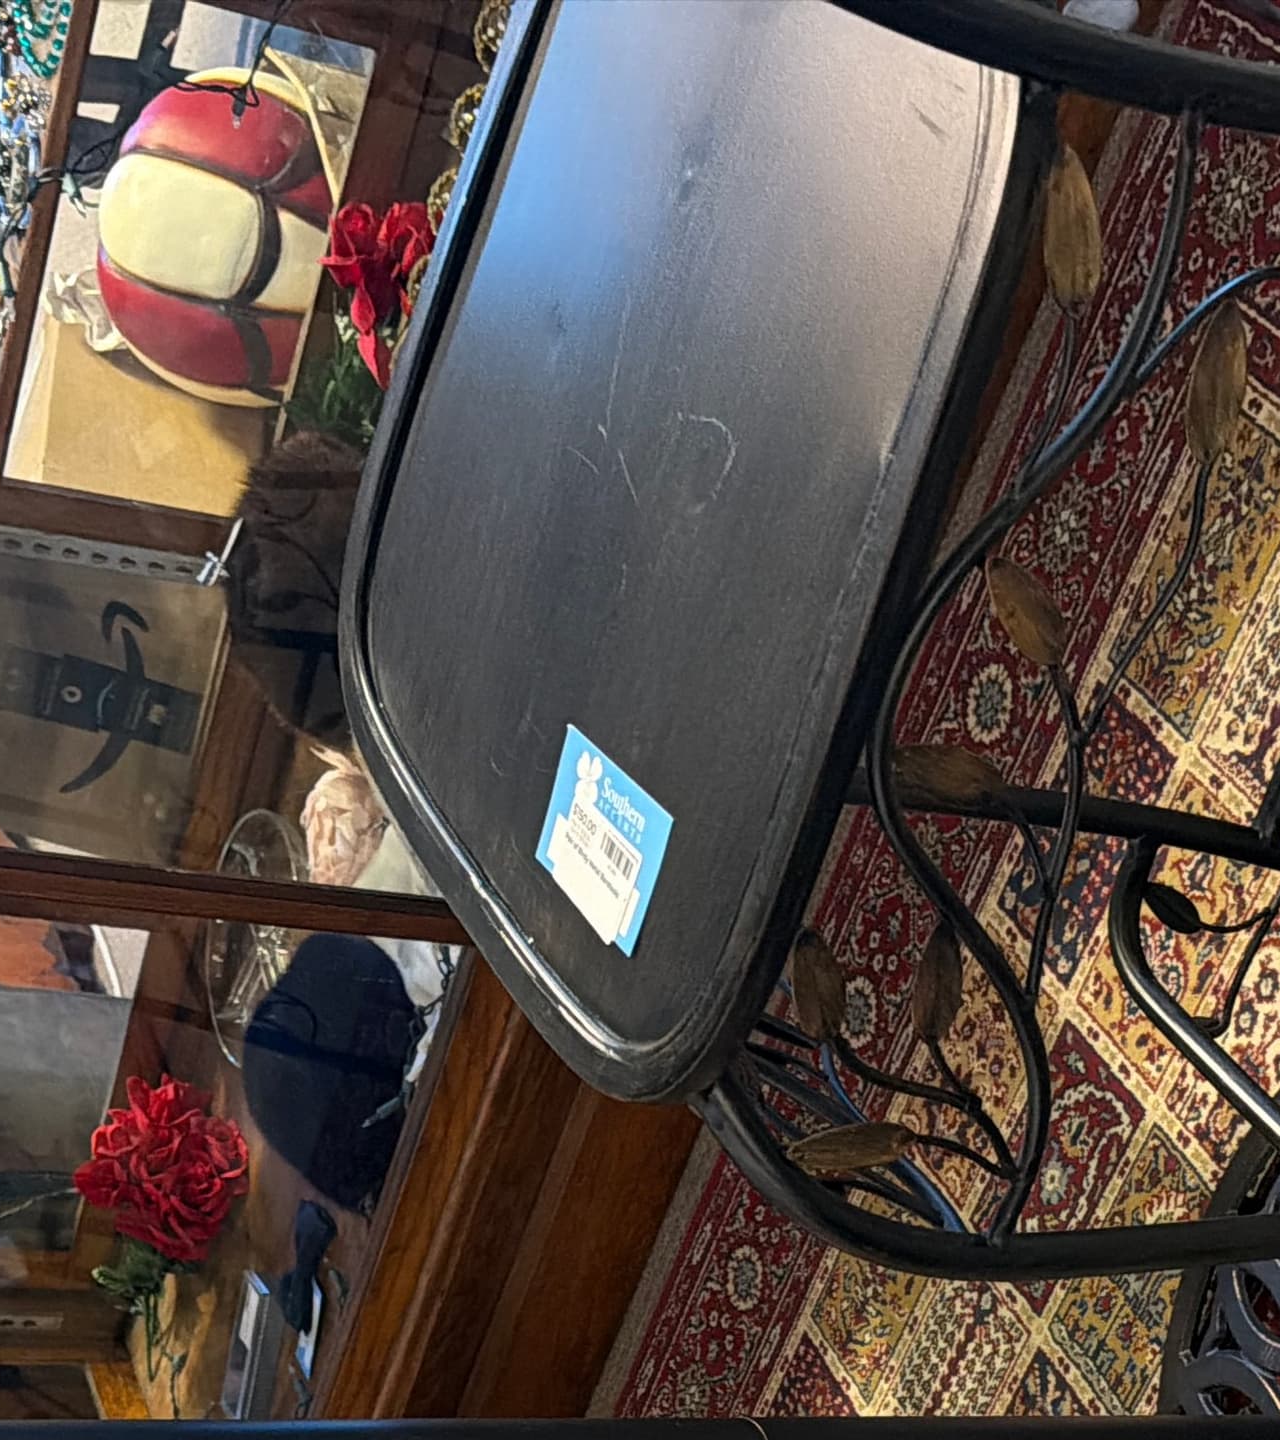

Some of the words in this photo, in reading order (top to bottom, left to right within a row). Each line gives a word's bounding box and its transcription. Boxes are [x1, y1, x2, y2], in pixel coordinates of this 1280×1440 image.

[573, 804, 597, 836] $150.00
[597, 800, 642, 845] ACCENTS
[601, 777, 646, 833] Southern
